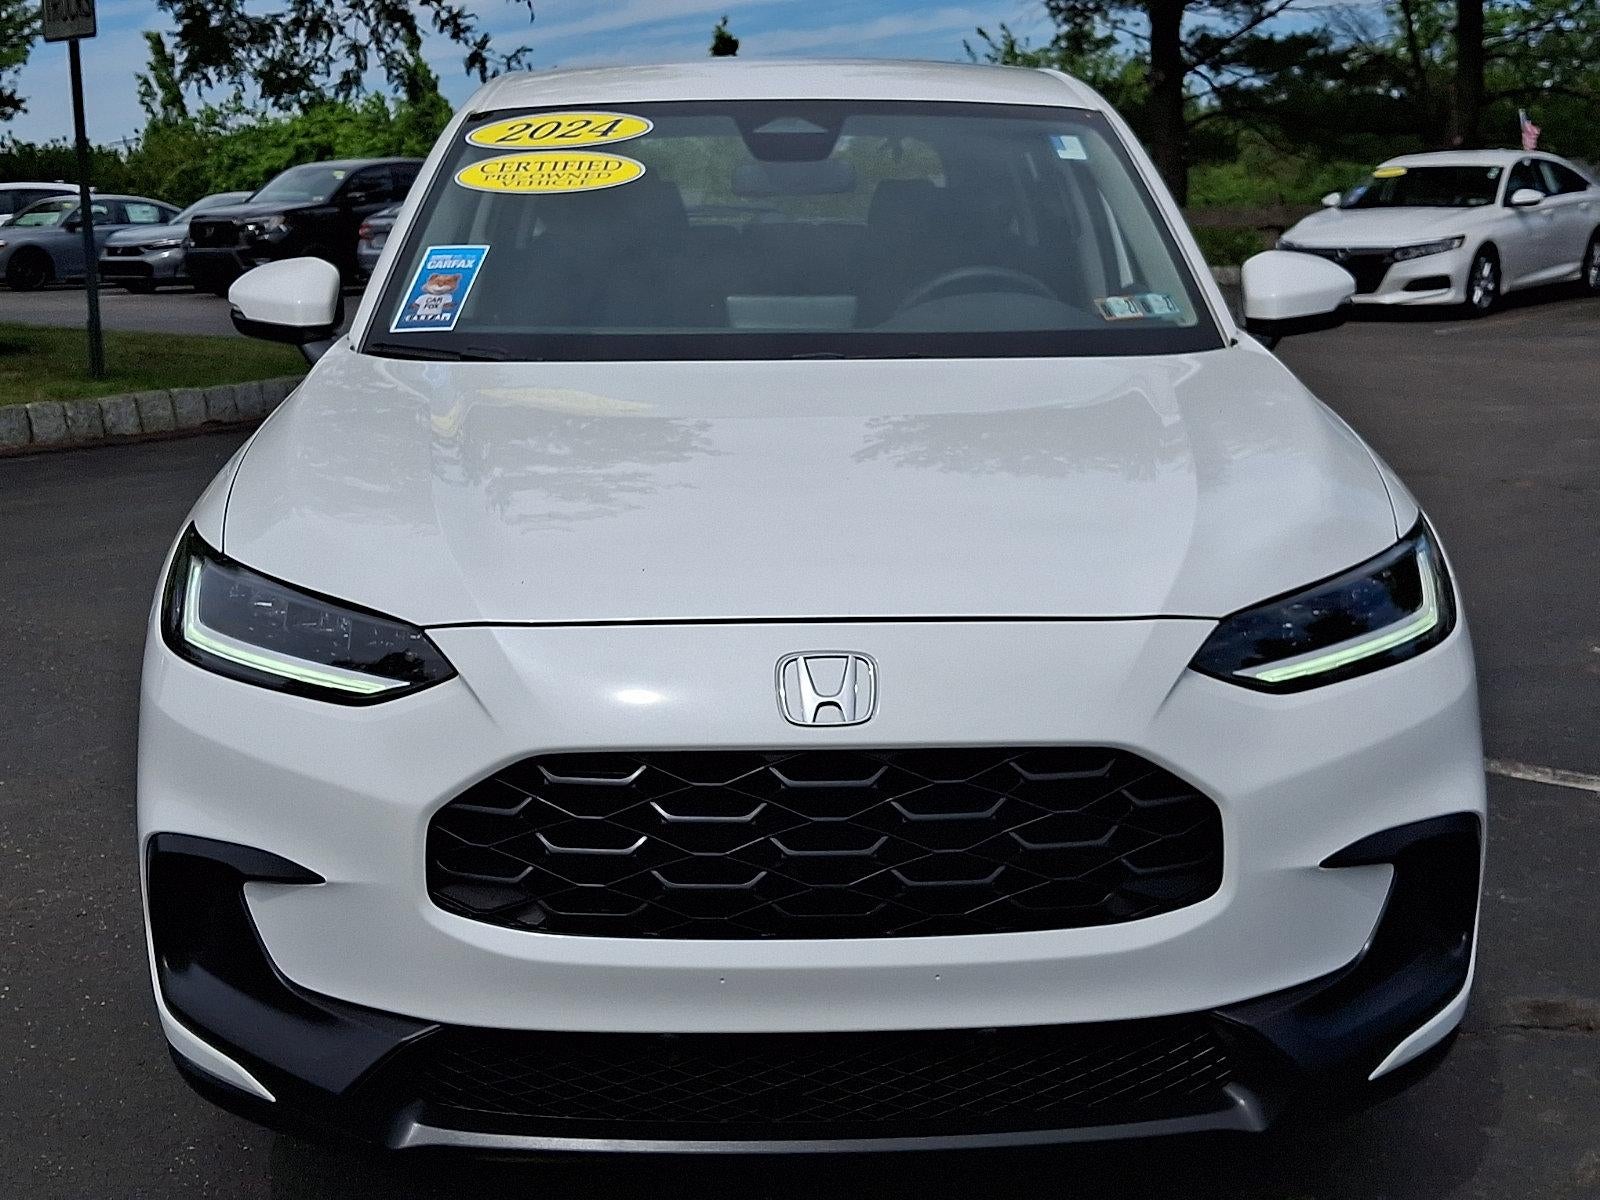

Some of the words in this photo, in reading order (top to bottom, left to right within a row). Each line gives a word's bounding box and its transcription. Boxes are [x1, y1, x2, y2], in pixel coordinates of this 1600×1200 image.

[495, 118, 623, 143] 2024
[480, 160, 623, 174] CERTIFIED
[484, 172, 612, 182] PRE-OWNED
[501, 179, 590, 188] VEHICLE
[427, 259, 475, 269] CARFAX
